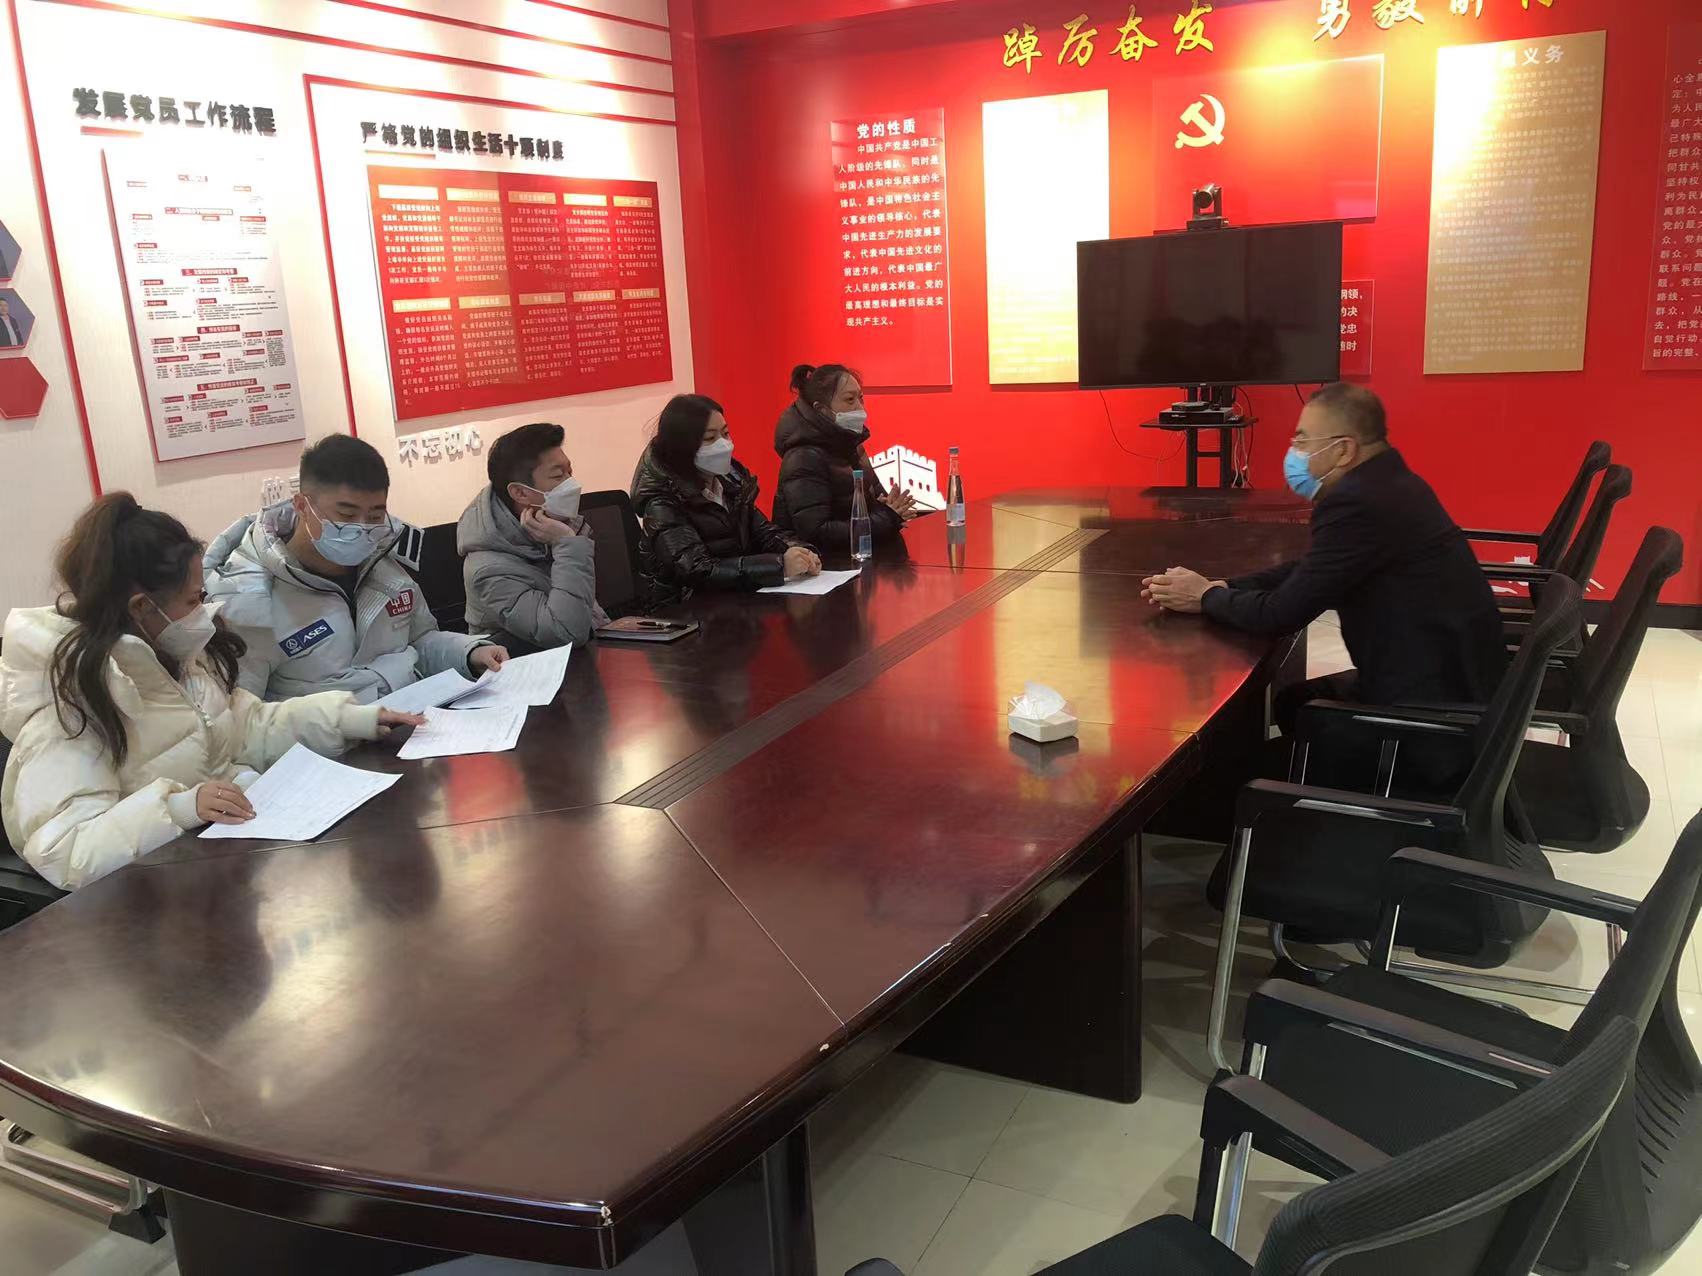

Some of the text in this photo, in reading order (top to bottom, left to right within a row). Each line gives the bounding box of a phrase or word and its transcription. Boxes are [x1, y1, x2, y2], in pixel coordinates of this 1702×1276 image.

[1003, 0, 1214, 74] 踔厉奋发
[72, 87, 277, 136] 发展党员工作流程
[857, 118, 916, 139] 党的性质
[360, 121, 564, 160] 严格党的组织生活十项制度
[857, 137, 938, 154] 中国共产党是中国工
[840, 173, 940, 190] 中国人民和中华民族的先
[1664, 192, 1702, 202] 利为民
[842, 226, 942, 243] 中国先进生产力的发展要
[845, 296, 944, 311] 最高理想和最终目标是实
[846, 316, 895, 328] 现共产主义。
[1654, 320, 1702, 330] 去，把党
[399, 426, 484, 466] 不忘初心
[303, 624, 328, 643] ASES
